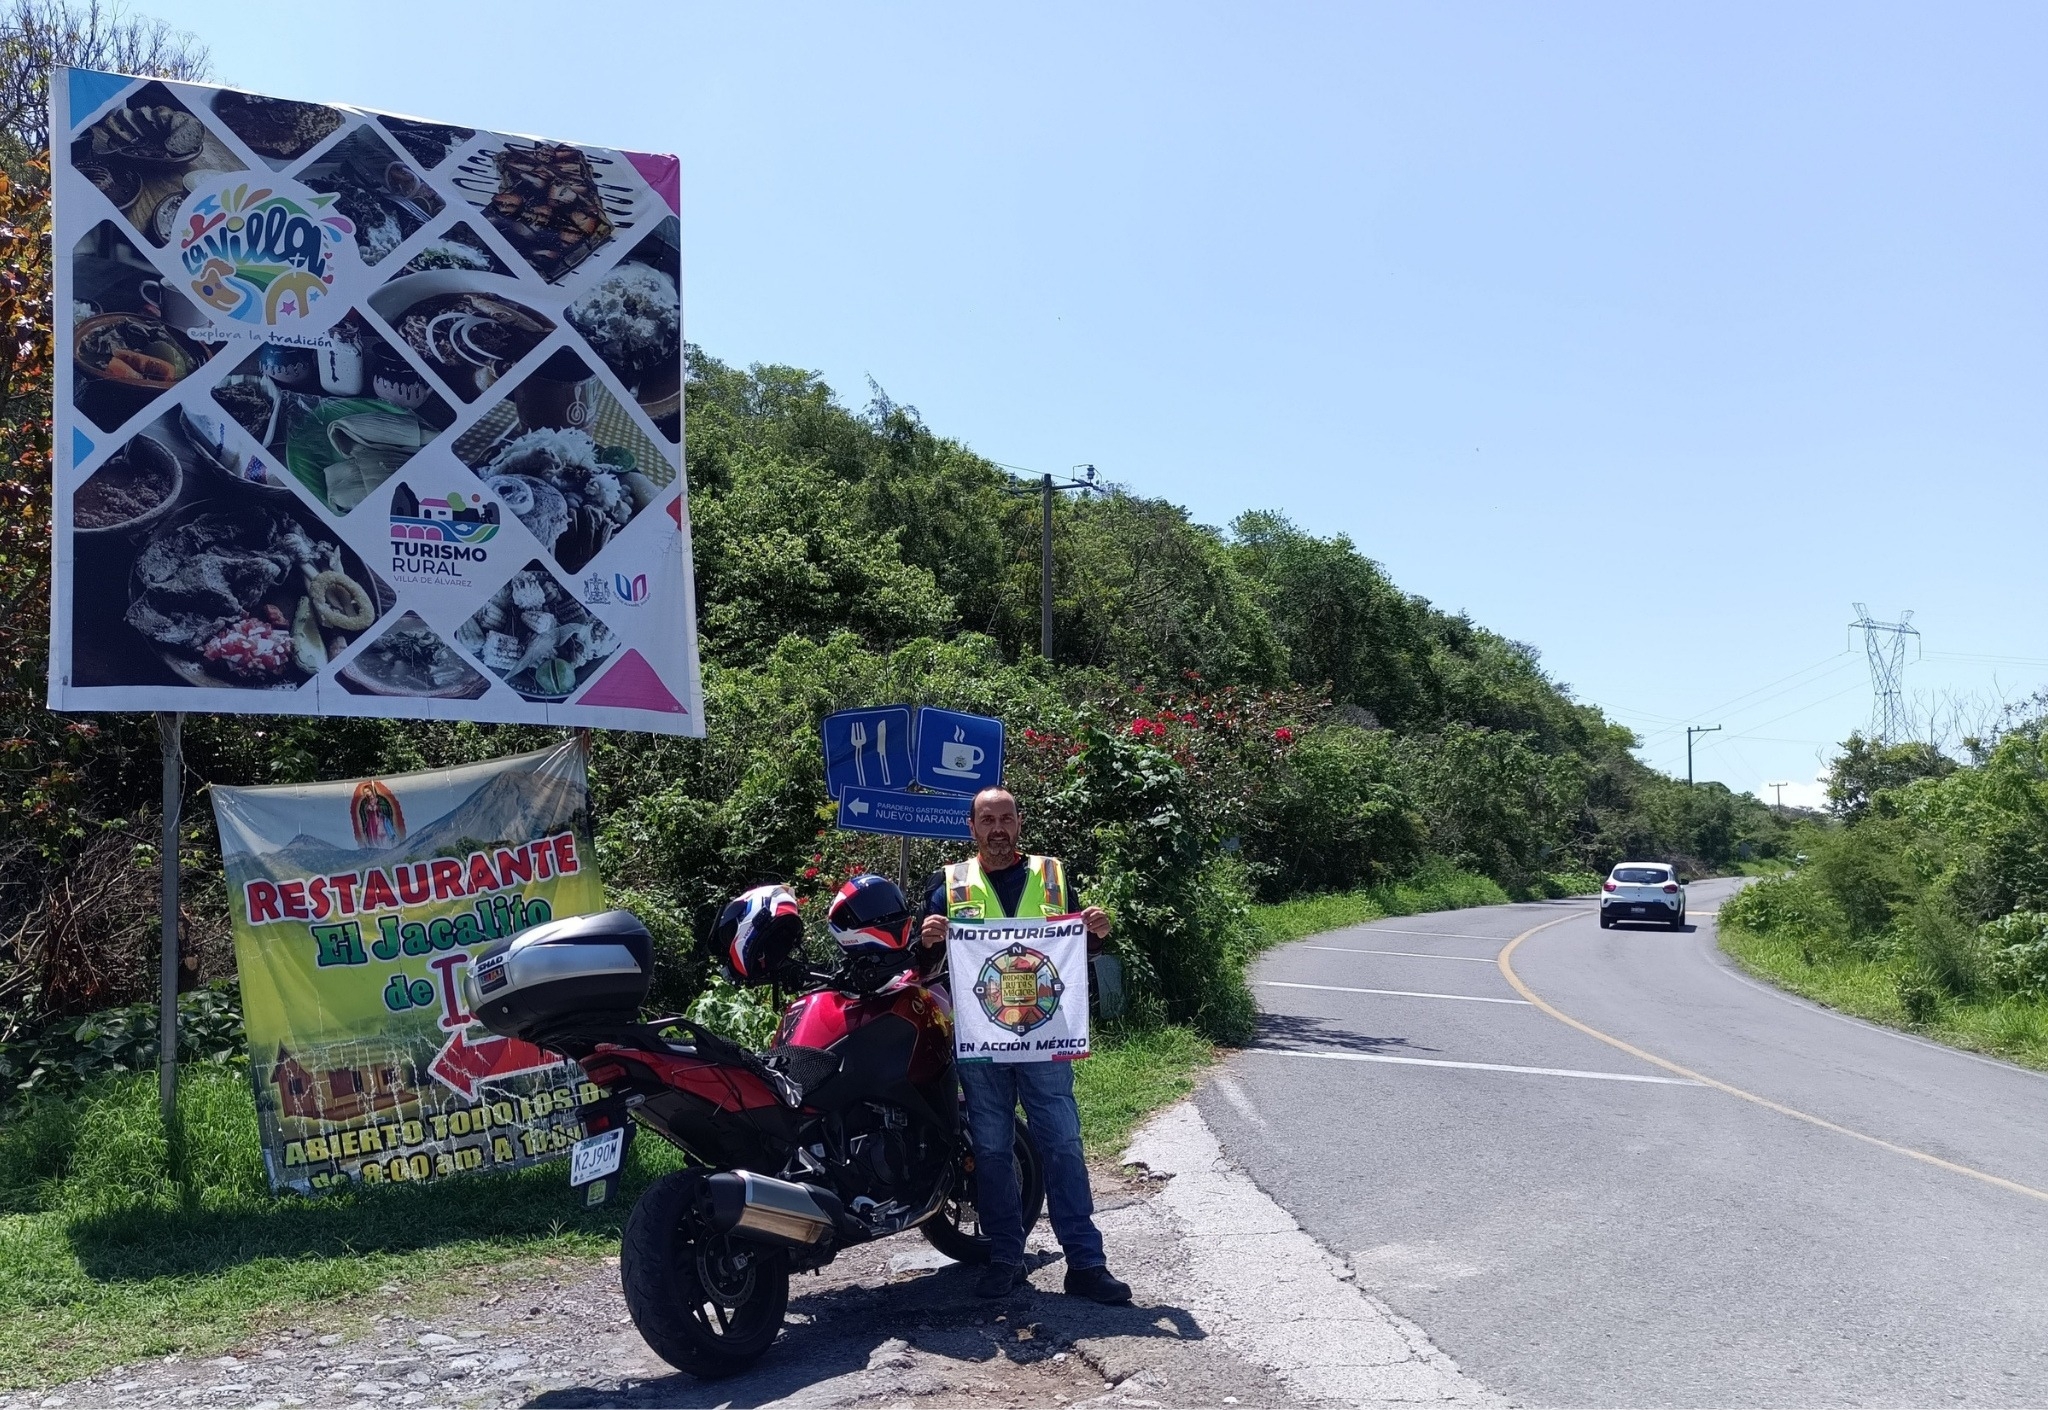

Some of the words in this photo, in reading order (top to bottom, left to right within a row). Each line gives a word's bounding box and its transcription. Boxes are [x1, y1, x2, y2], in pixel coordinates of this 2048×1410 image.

[190, 327, 241, 340] explora
[249, 329, 261, 341] la
[268, 330, 332, 348] tradición
[390, 540, 487, 562] TURISMO
[392, 557, 462, 577] RURAL
[393, 575, 418, 583] VILLA
[420, 576, 432, 584] DE
[434, 576, 472, 587] ÁLVAREZ
[875, 809, 913, 822] NUEVO
[877, 802, 914, 813] PARADERO
[245, 833, 579, 923] RESTAURANTE
[312, 919, 367, 966] El
[372, 894, 552, 960] Jacalito
[1012, 946, 1022, 954] N
[477, 955, 504, 972] SHAD
[385, 975, 434, 1011] de
[960, 1042, 975, 1052] EN
[980, 1038, 1030, 1052] ACCIÓN
[1036, 1037, 1086, 1050] MÉXICO
[285, 1118, 425, 1166] ABIERTO
[428, 1100, 514, 1141] TODO
[494, 1135, 515, 1163] A
